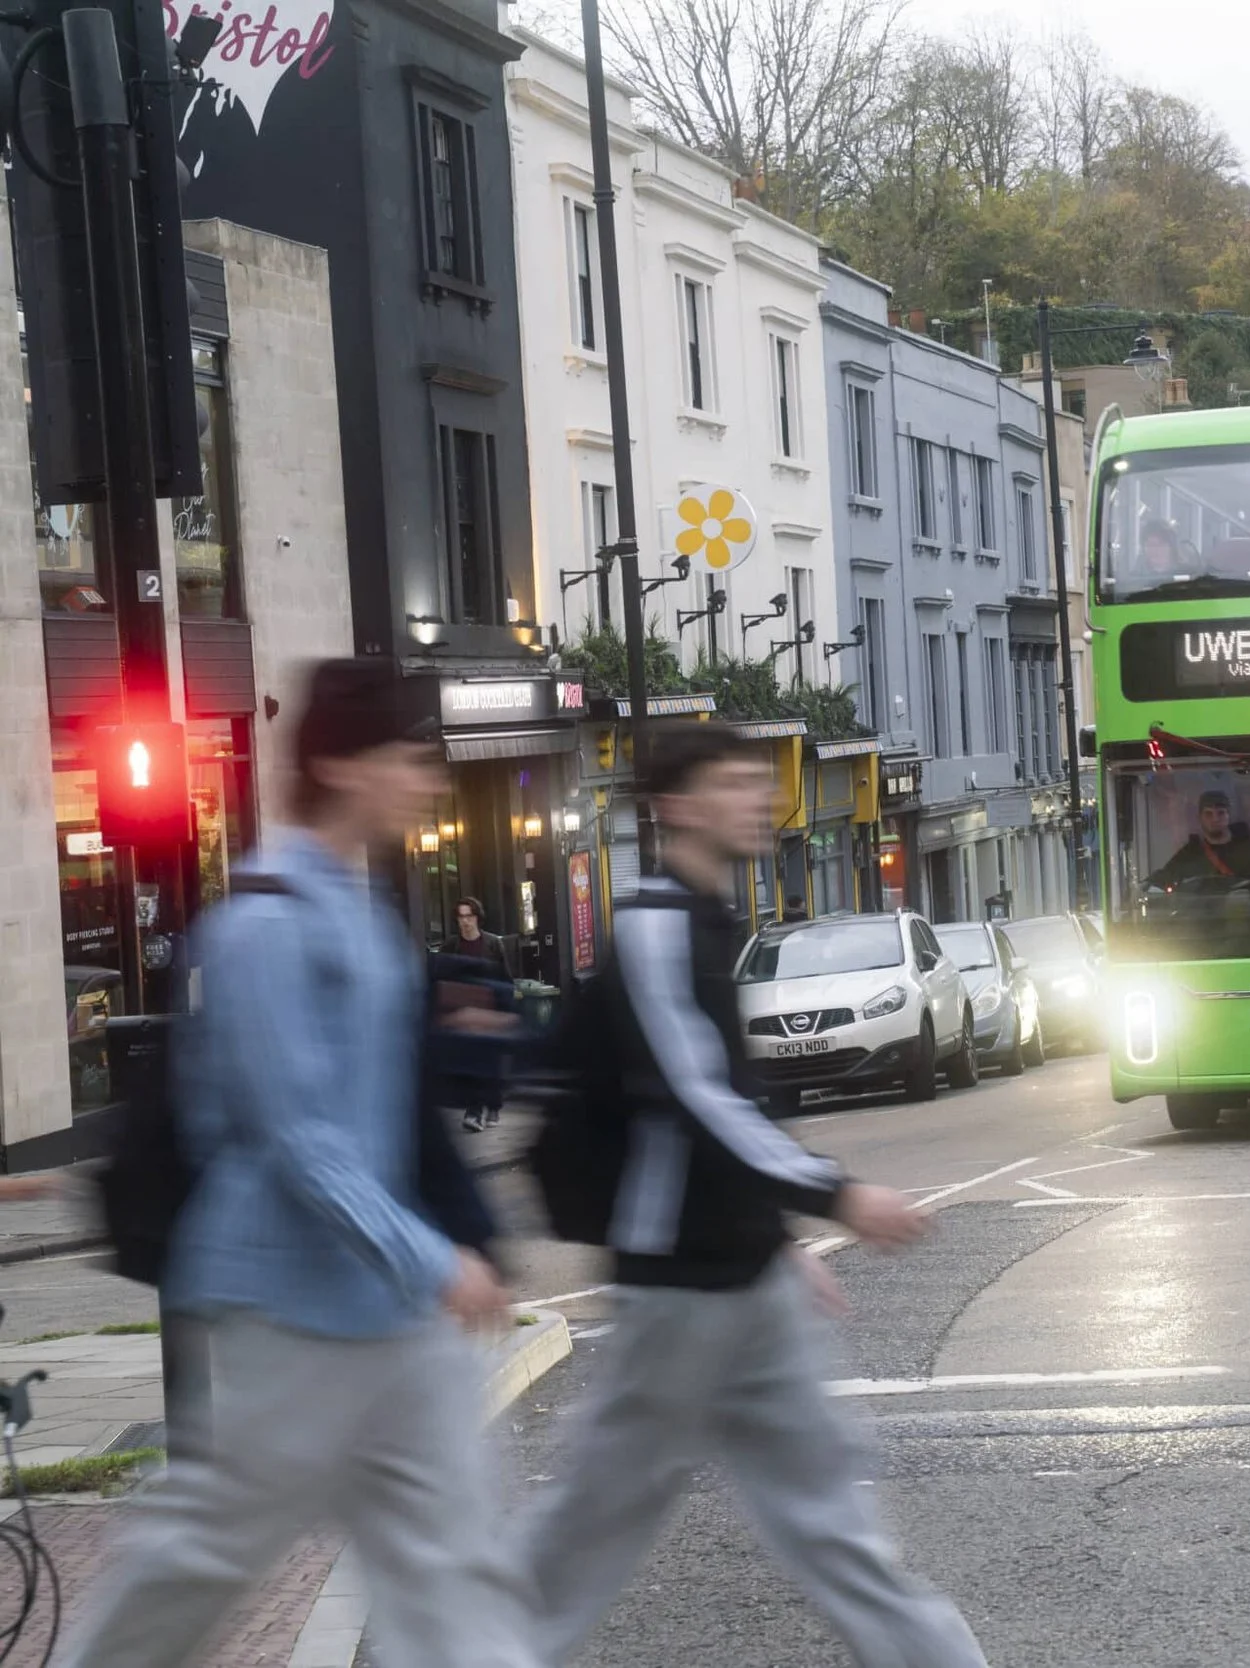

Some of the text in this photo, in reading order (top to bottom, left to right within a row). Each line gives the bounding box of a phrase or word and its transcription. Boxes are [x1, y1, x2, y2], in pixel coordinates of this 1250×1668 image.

[161, 0, 336, 80] Bistol
[145, 575, 160, 597] 2
[777, 1040, 829, 1056] CK13 NDD
